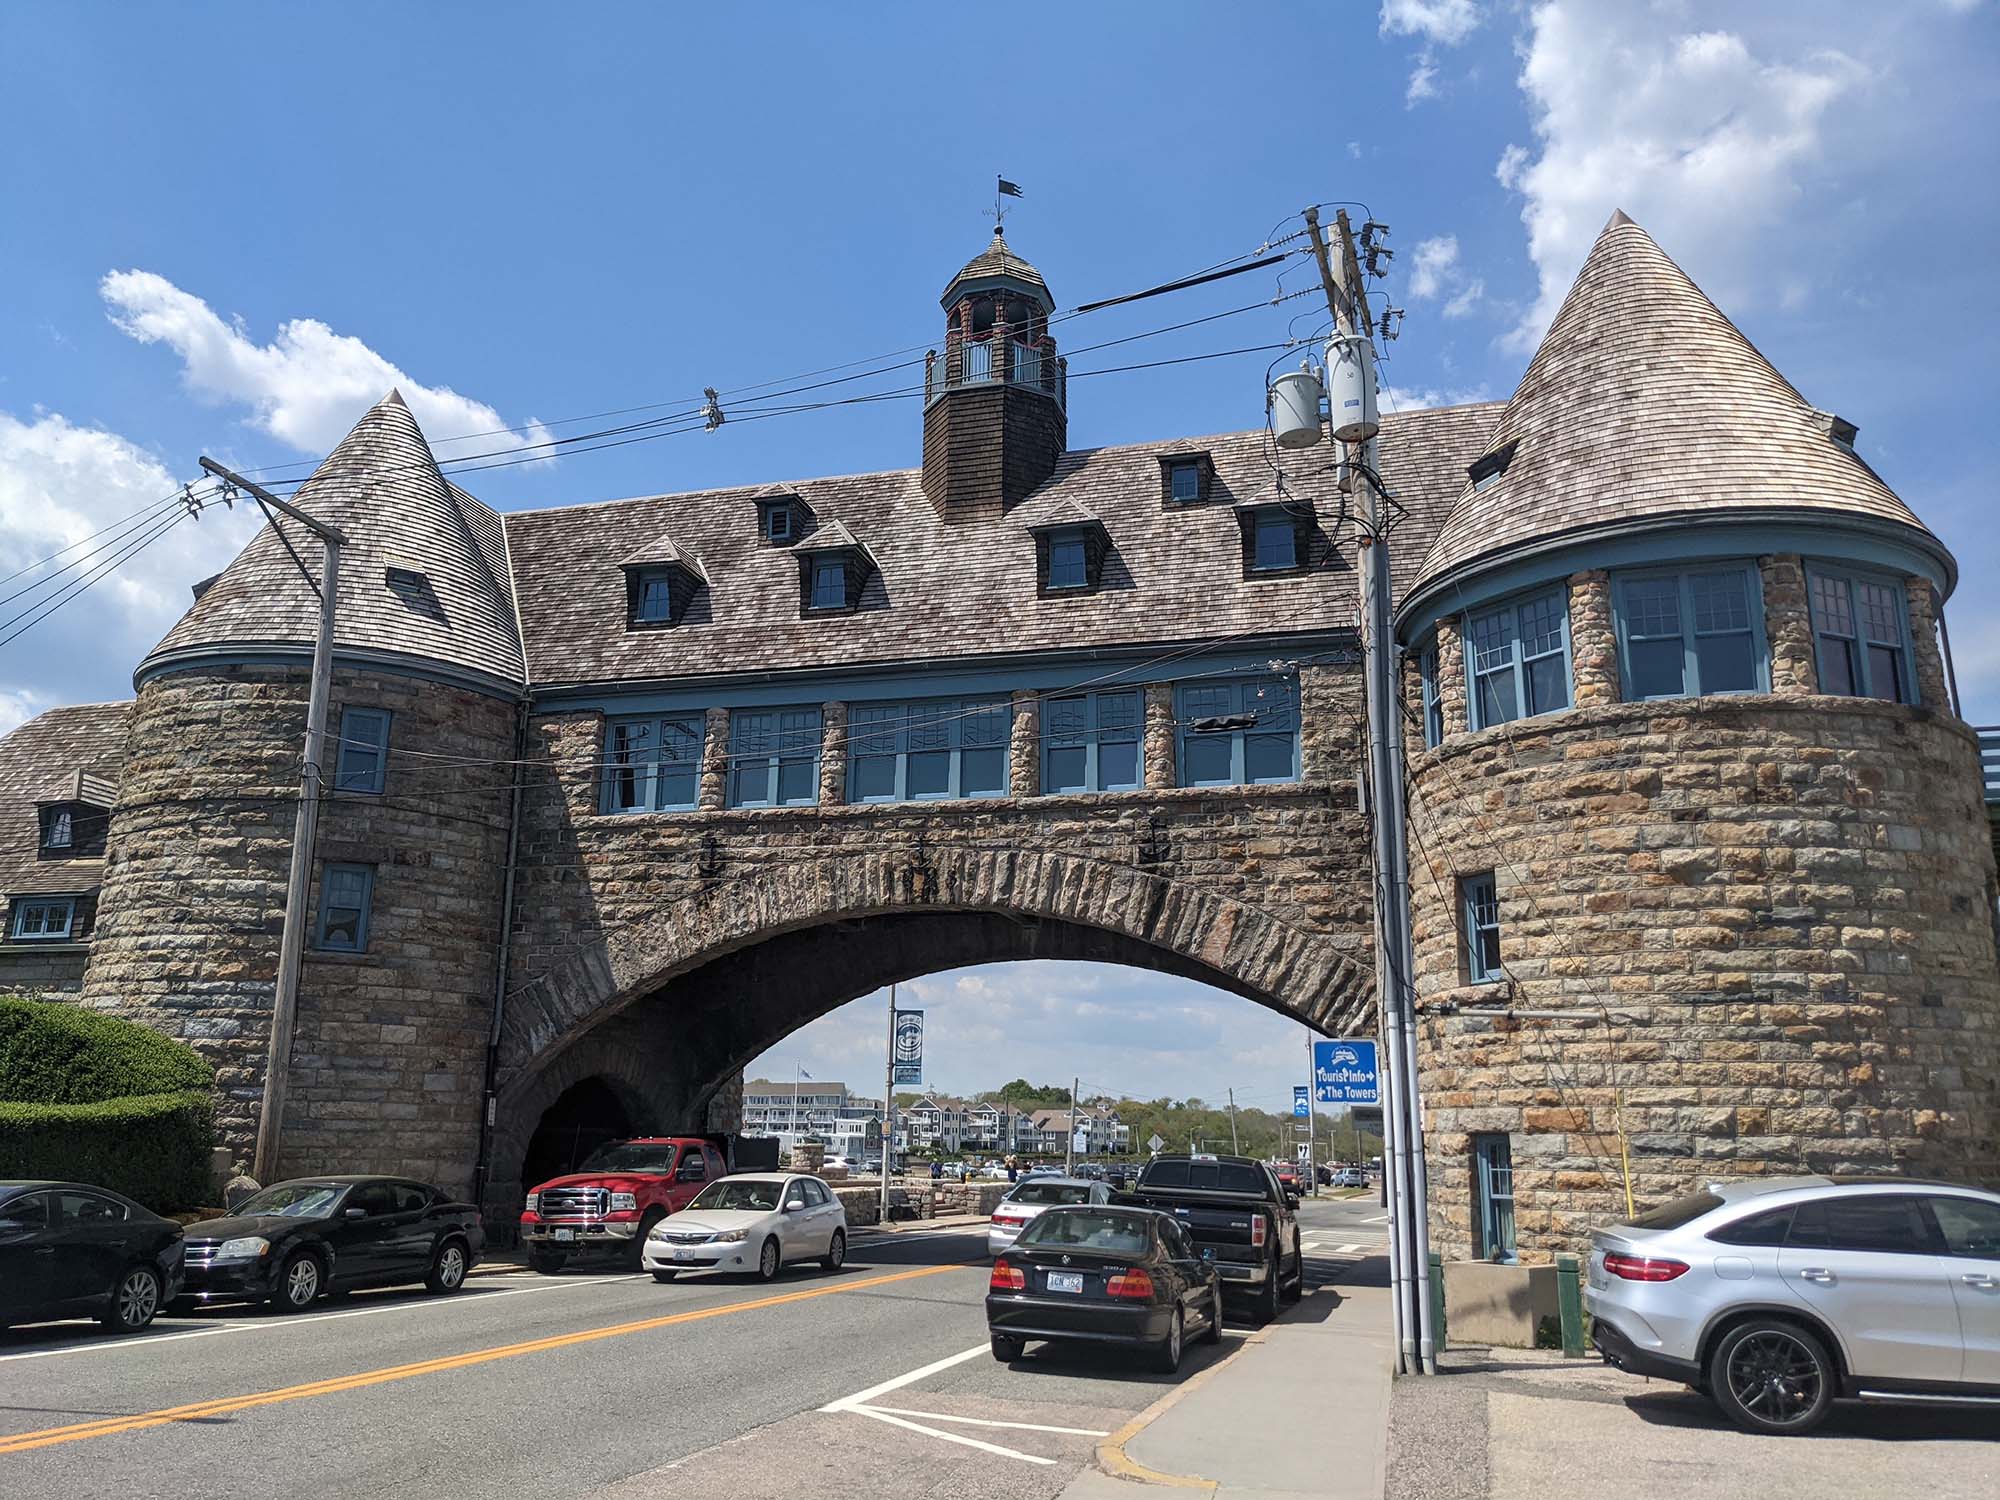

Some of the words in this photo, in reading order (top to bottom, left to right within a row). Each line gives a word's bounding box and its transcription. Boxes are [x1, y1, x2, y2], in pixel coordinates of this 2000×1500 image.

[1316, 1068, 1348, 1082] Tourist
[1349, 1069, 1366, 1082] Info
[1326, 1086, 1343, 1098] The
[1344, 1086, 1377, 1099] Towers
